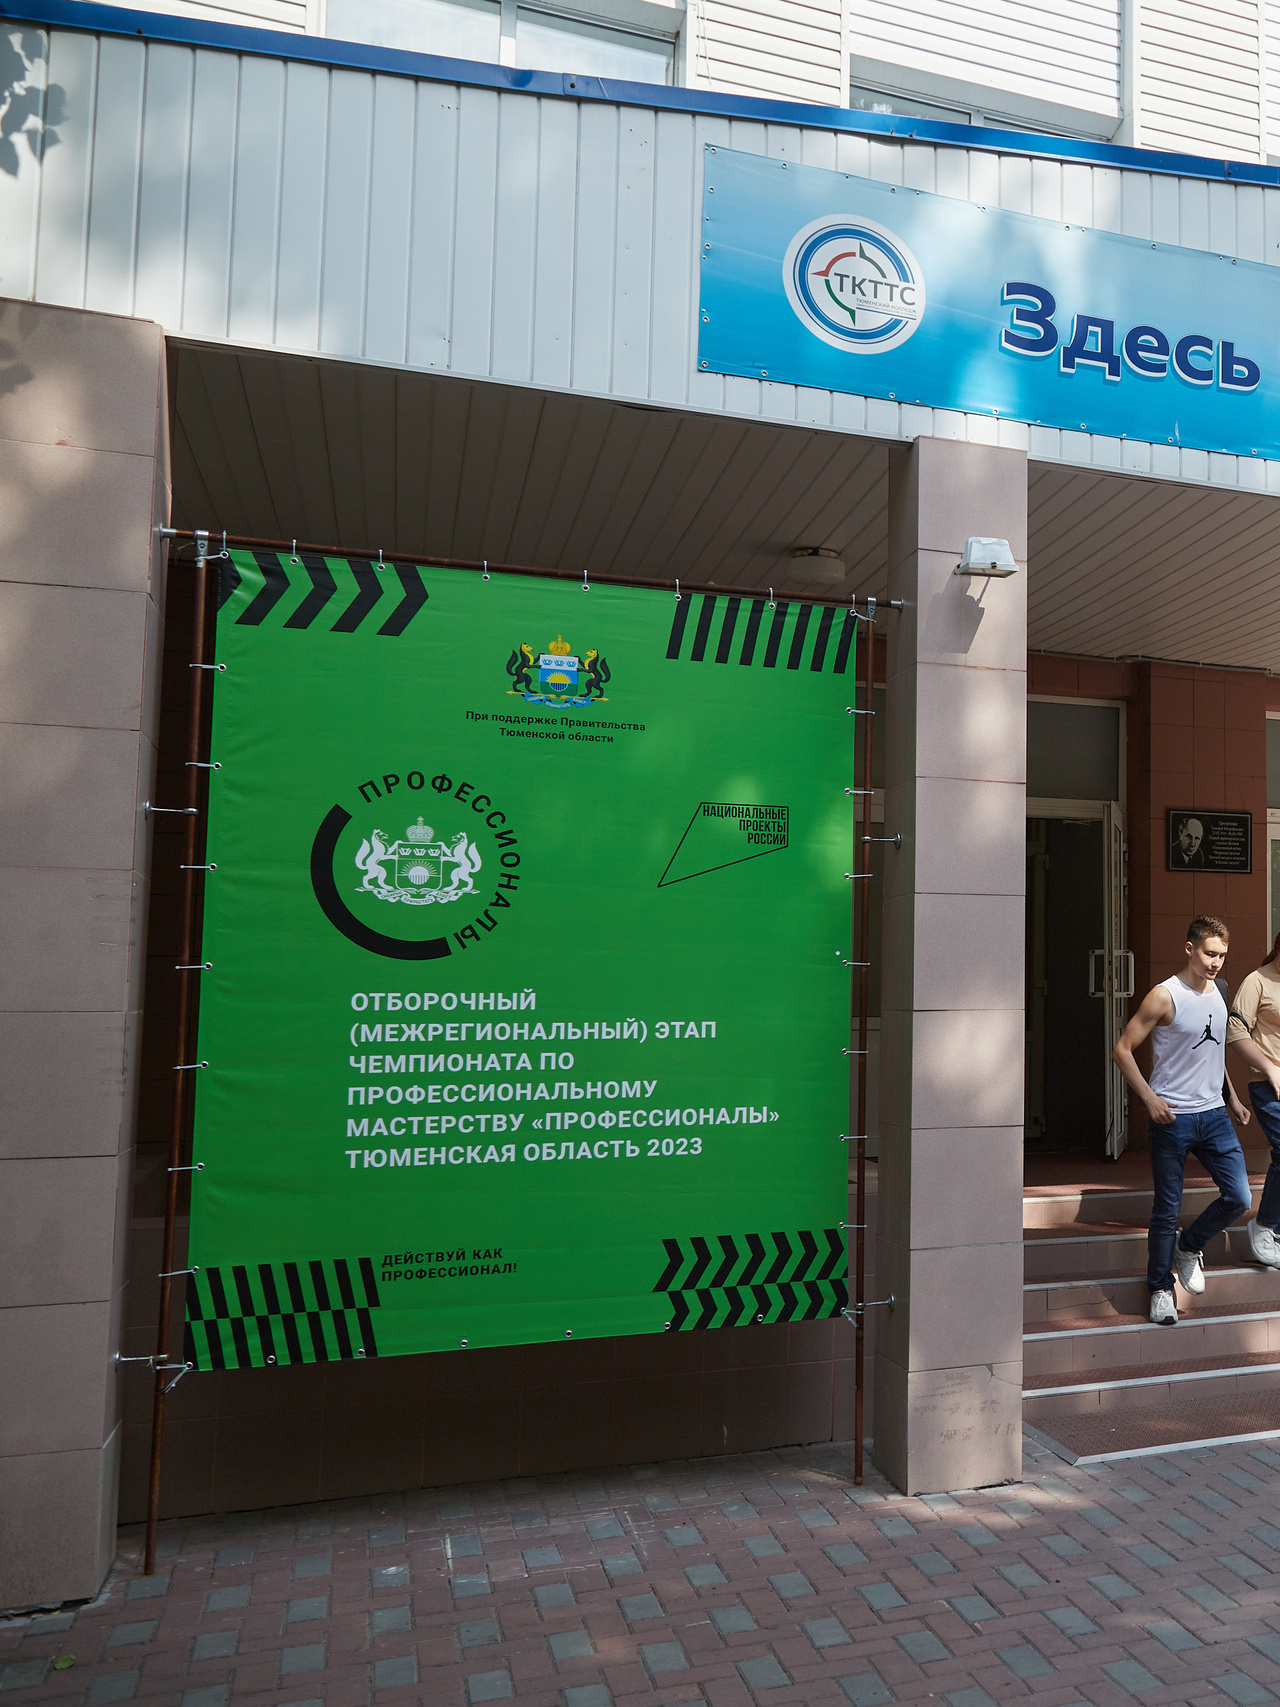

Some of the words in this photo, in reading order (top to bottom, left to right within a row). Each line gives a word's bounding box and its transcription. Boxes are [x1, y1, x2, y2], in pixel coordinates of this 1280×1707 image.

[834, 272, 915, 305] ТКТТС
[1000, 280, 1262, 392] Здесь
[465, 711, 489, 721] При
[491, 713, 558, 726] поддержке
[560, 717, 646, 731] Правительства
[499, 727, 565, 740] Тюменской
[568, 731, 614, 743] области
[703, 805, 786, 820] НАЦИОНАЛЬНЫЕ
[739, 820, 786, 832] ПРОЕКТЫ
[747, 833, 786, 845] РОССИИ
[357, 771, 521, 950] ПРОФЕССИОНАЛЫ
[350, 988, 538, 1013] ОТБОРОЧНЫЙ
[349, 1018, 649, 1047] (МЕЖРЕГИОНАЛЬНЫЙ)
[654, 1021, 718, 1040] ЭТАП
[349, 1051, 533, 1074] ЧЕМПИОНАТА
[539, 1051, 575, 1071] ПО
[347, 1079, 658, 1106] ПРОФЕССИОНАЛЬНОМУ
[346, 1112, 526, 1138] МАСТЕРСТВУ
[531, 1106, 781, 1131] «ПРОФЕССИОНАЛЫ»
[345, 1143, 516, 1170] ТЮМЕНСКАЯ
[523, 1139, 642, 1162] ОБЛАСТЬ
[646, 1137, 704, 1158] 2023
[381, 1248, 466, 1268] ДЕЙСТВУЙ
[472, 1248, 503, 1260] КАК
[381, 1263, 518, 1282] ПРОФЕССИОНАЛ!
